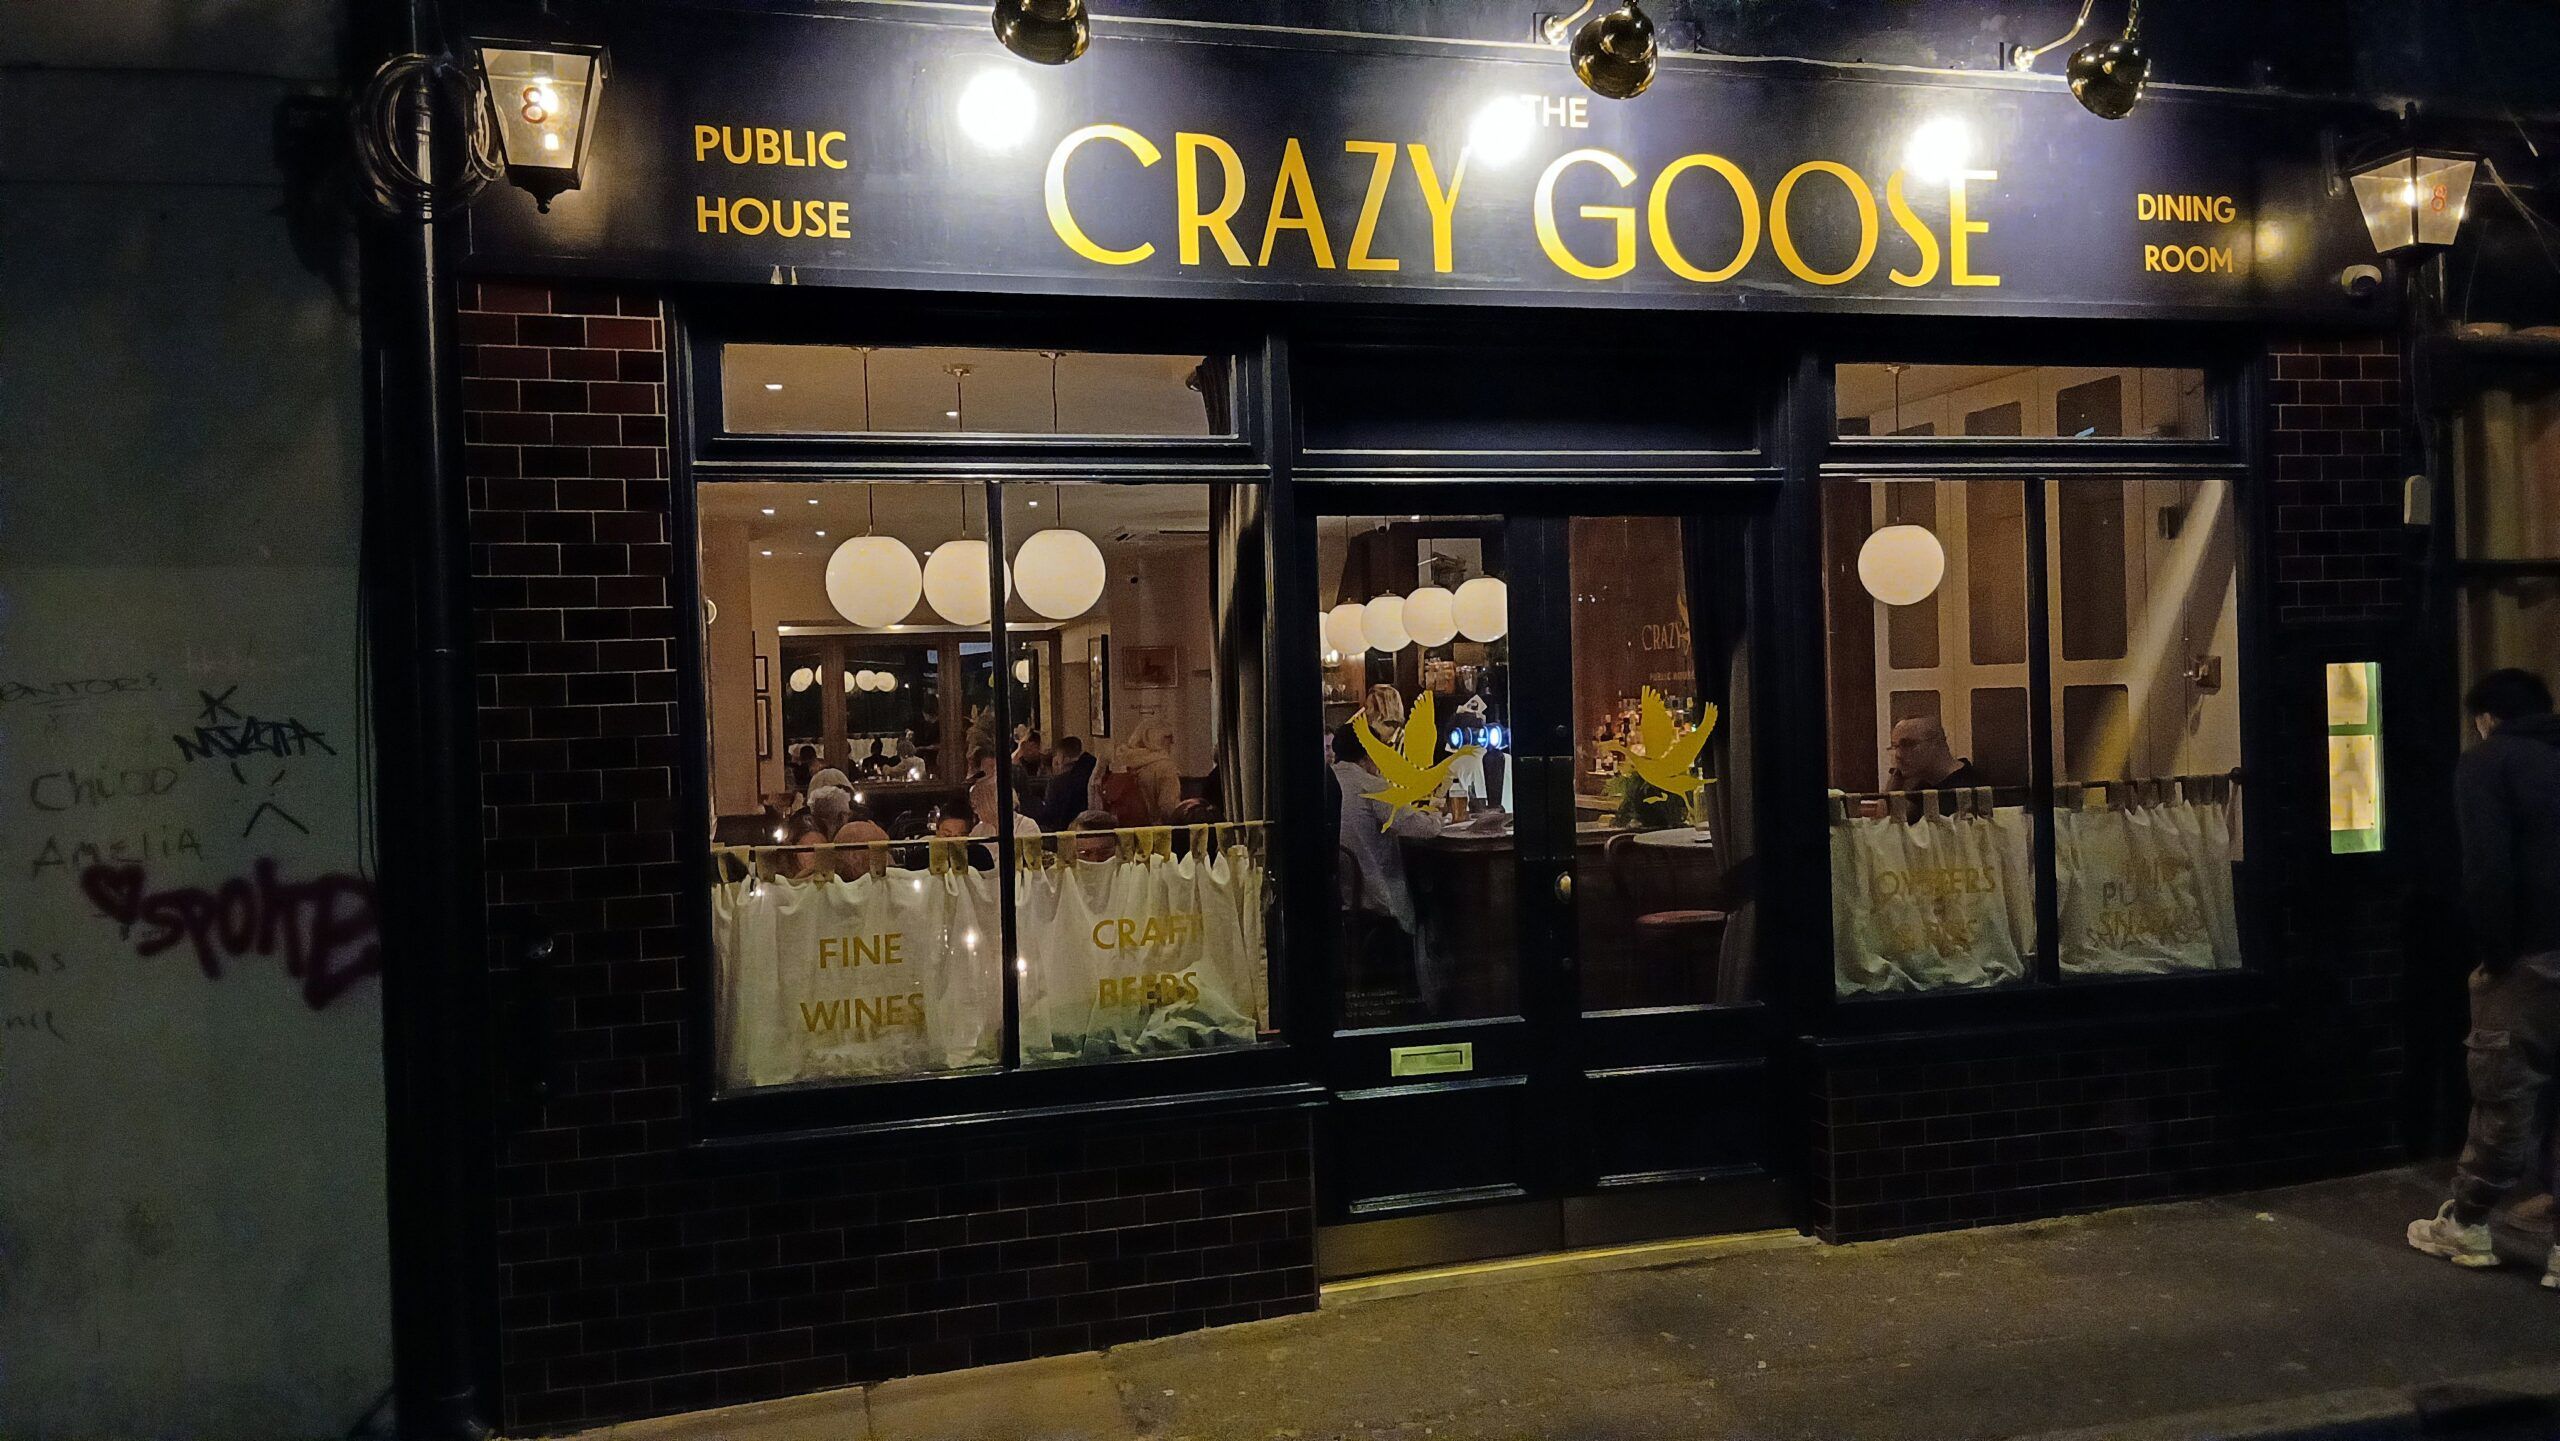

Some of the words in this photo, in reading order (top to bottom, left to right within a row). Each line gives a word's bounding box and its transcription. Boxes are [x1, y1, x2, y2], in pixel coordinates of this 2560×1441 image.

[522, 86, 549, 124] 8
[1519, 94, 1590, 129] THE
[694, 124, 847, 169] PUBLIC
[1044, 124, 1471, 273] CRAZY
[1533, 149, 2001, 287] GOOSE
[2137, 193, 2236, 224] DINING
[2431, 183, 2448, 212] 8
[695, 195, 852, 240] HOUSE
[2144, 244, 2234, 274] ROOM
[818, 932, 904, 970] FINE
[1092, 914, 1204, 950] CRAFT
[1099, 971, 1199, 1011] BEERS
[799, 991, 927, 1033] WINES
